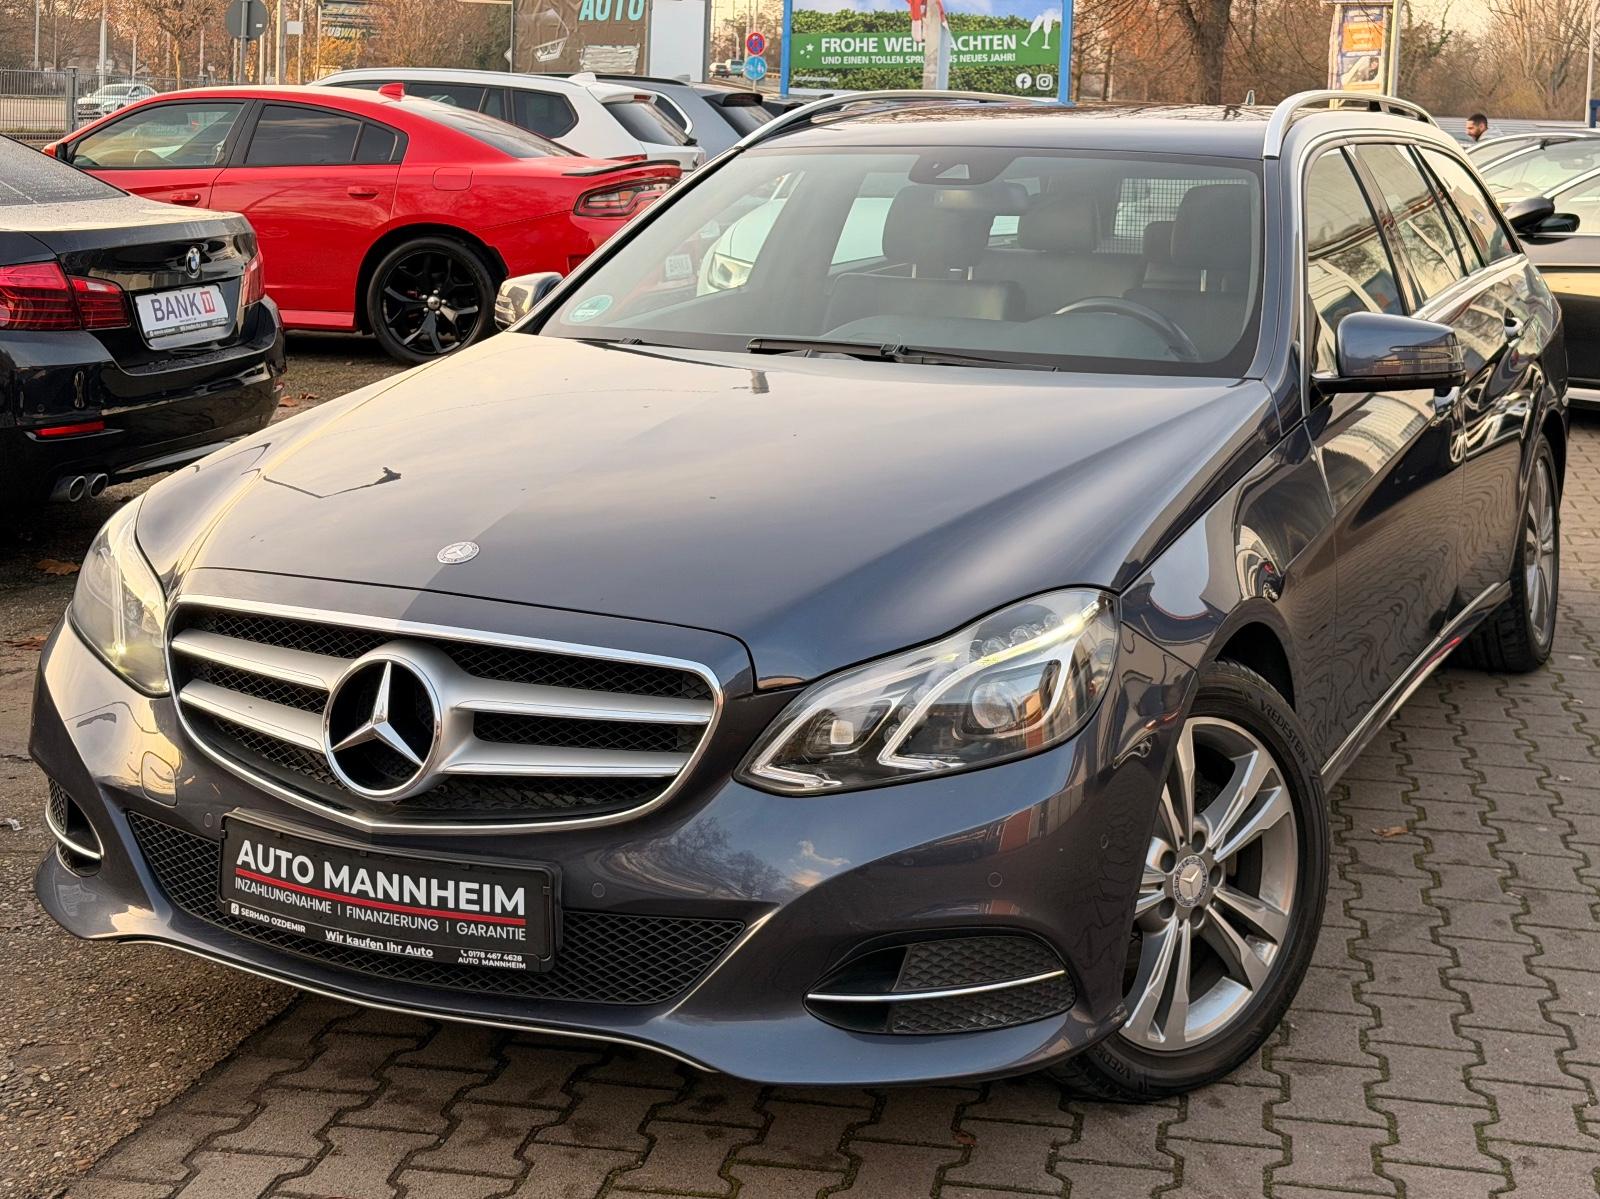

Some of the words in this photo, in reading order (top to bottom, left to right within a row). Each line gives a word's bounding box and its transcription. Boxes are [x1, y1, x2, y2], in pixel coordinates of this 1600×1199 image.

[579, 0, 645, 21] AUTO
[821, 37, 878, 52] FROHE
[883, 34, 1017, 53] WEIACHTEN
[821, 56, 842, 65] UND
[843, 55, 869, 64] EINEN
[871, 55, 904, 64] TOLLEN
[905, 55, 926, 64] SPRU
[960, 53, 988, 63] NEUES
[990, 53, 1016, 62] JAHR!
[151, 292, 202, 322] BANK
[1259, 698, 1309, 764] VREDESTEIN
[236, 839, 314, 884] AUTO
[324, 861, 525, 916] MANNHEIM
[234, 876, 332, 914] INZAHLUNGNAHME
[346, 906, 439, 932] FINANZIERUNG
[456, 922, 527, 941] GARANTIE
[240, 907, 270, 924] SERHAD
[271, 917, 306, 934] OZDEMIR
[325, 929, 344, 943] Wir
[346, 933, 384, 951] kaufen
[387, 942, 402, 954] Ihr
[405, 944, 434, 957] Auto
[468, 950, 485, 958] 0178
[487, 952, 501, 960] 467
[503, 953, 523, 961] 4628
[457, 956, 479, 965] AUTO
[482, 959, 526, 969] MANNHEIM
